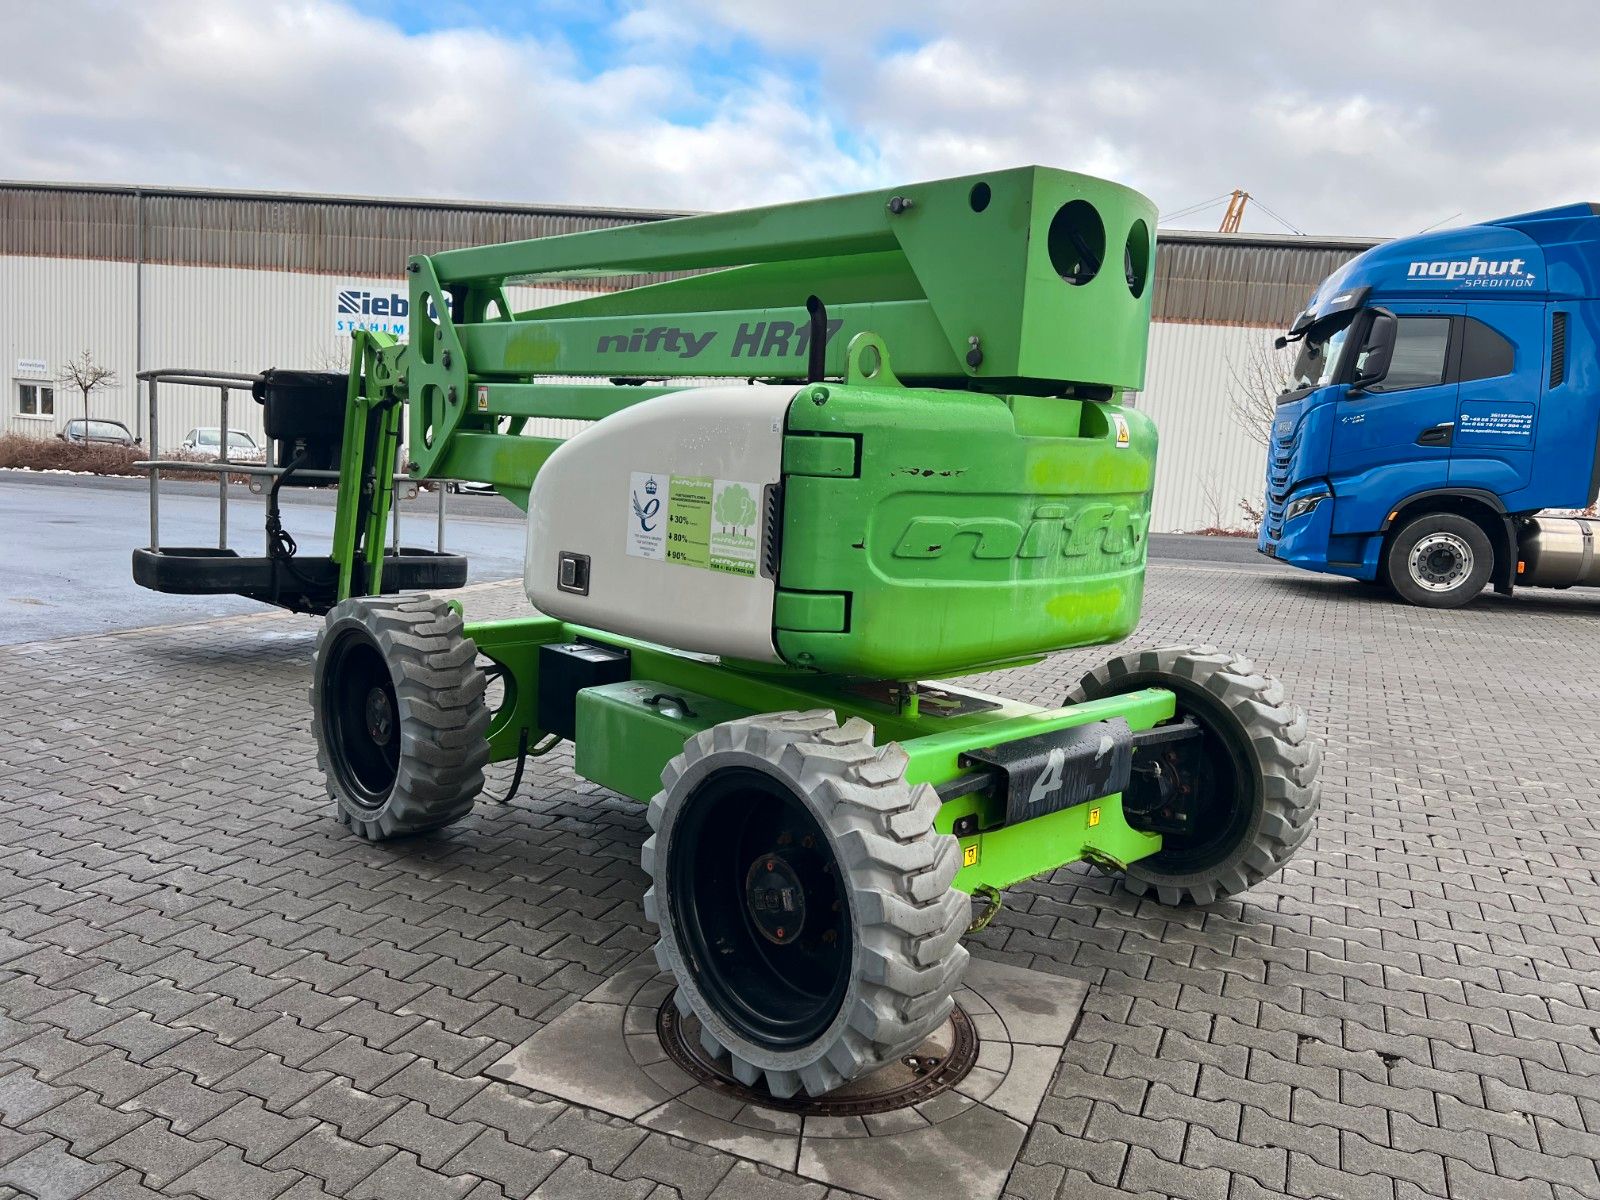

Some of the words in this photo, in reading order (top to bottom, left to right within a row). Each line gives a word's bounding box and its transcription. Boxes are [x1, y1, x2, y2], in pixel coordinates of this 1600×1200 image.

[1407, 257, 1525, 279] nophut
[1464, 279, 1533, 288] SPEDITION
[597, 327, 718, 358] nifty
[731, 319, 844, 358] HR17
[674, 515, 689, 525] 30%
[673, 533, 688, 543] 80%
[672, 551, 687, 561] 90%
